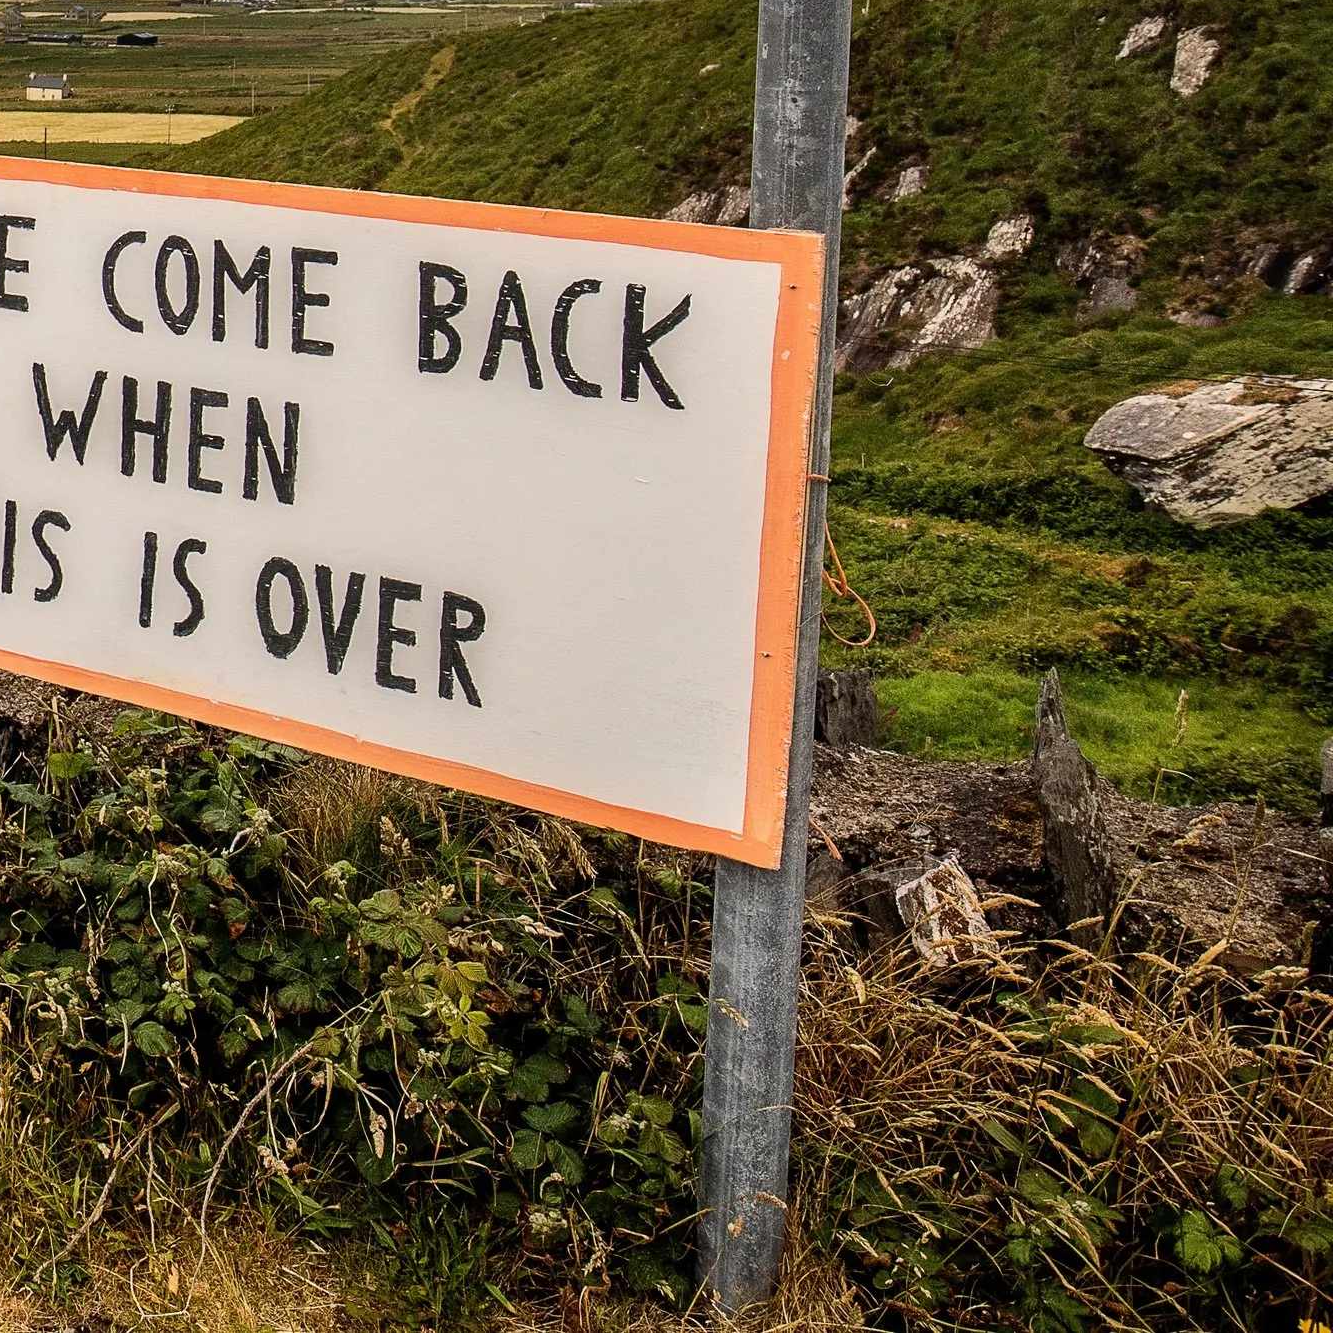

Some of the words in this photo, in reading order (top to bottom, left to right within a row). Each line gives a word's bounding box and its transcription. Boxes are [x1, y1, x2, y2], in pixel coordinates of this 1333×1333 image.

[102, 231, 338, 356] COME
[418, 261, 692, 410] BACK
[33, 363, 300, 505] WHEN
[139, 532, 206, 637] IS
[256, 557, 485, 708] OVER
